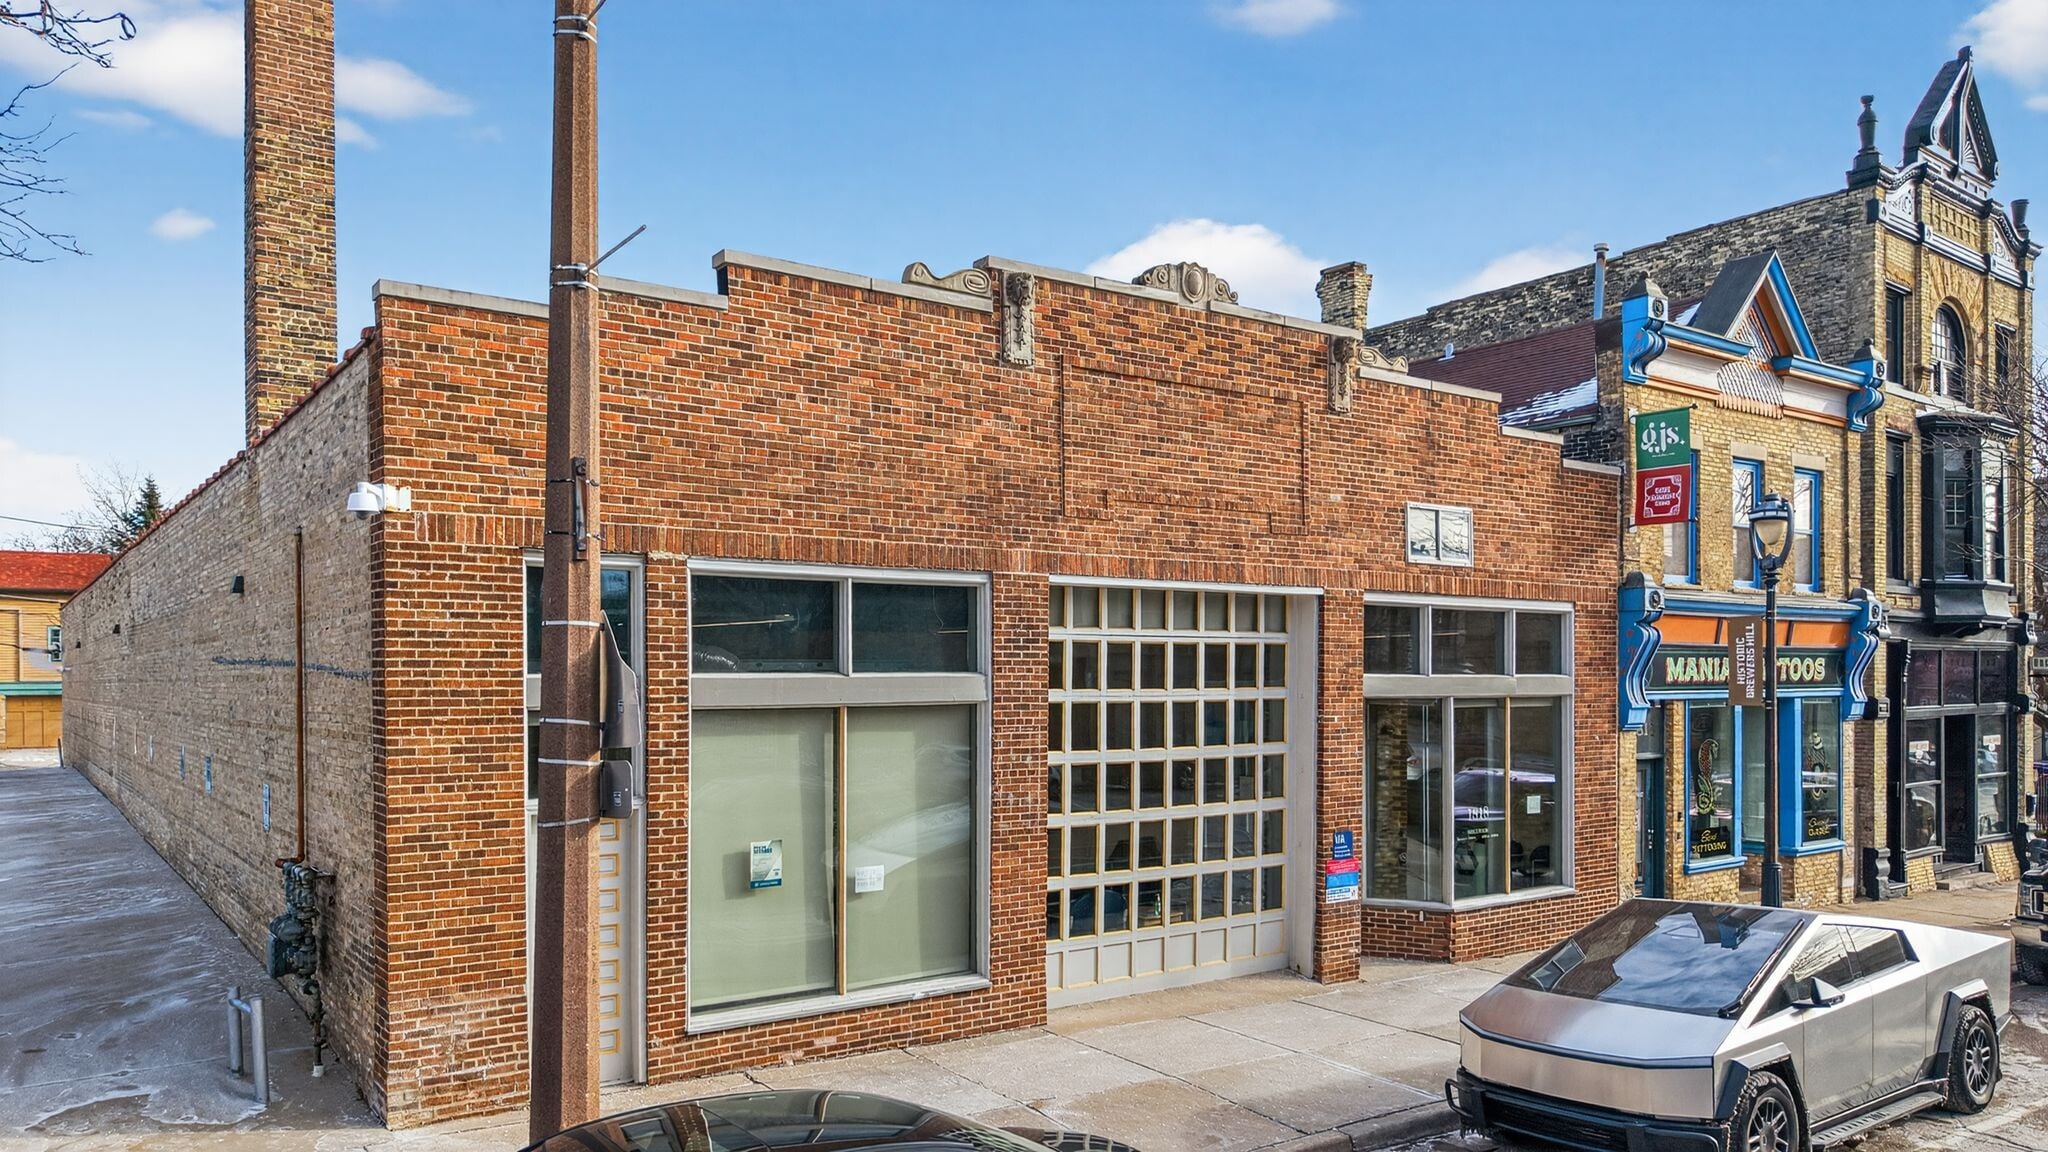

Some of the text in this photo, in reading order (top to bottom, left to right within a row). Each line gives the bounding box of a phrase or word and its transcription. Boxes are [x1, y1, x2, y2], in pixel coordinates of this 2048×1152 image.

[1666, 656, 1729, 683] MANIA
[1736, 637, 1746, 685] HISTORIC
[1745, 622, 1755, 699] BREWERS HILL
